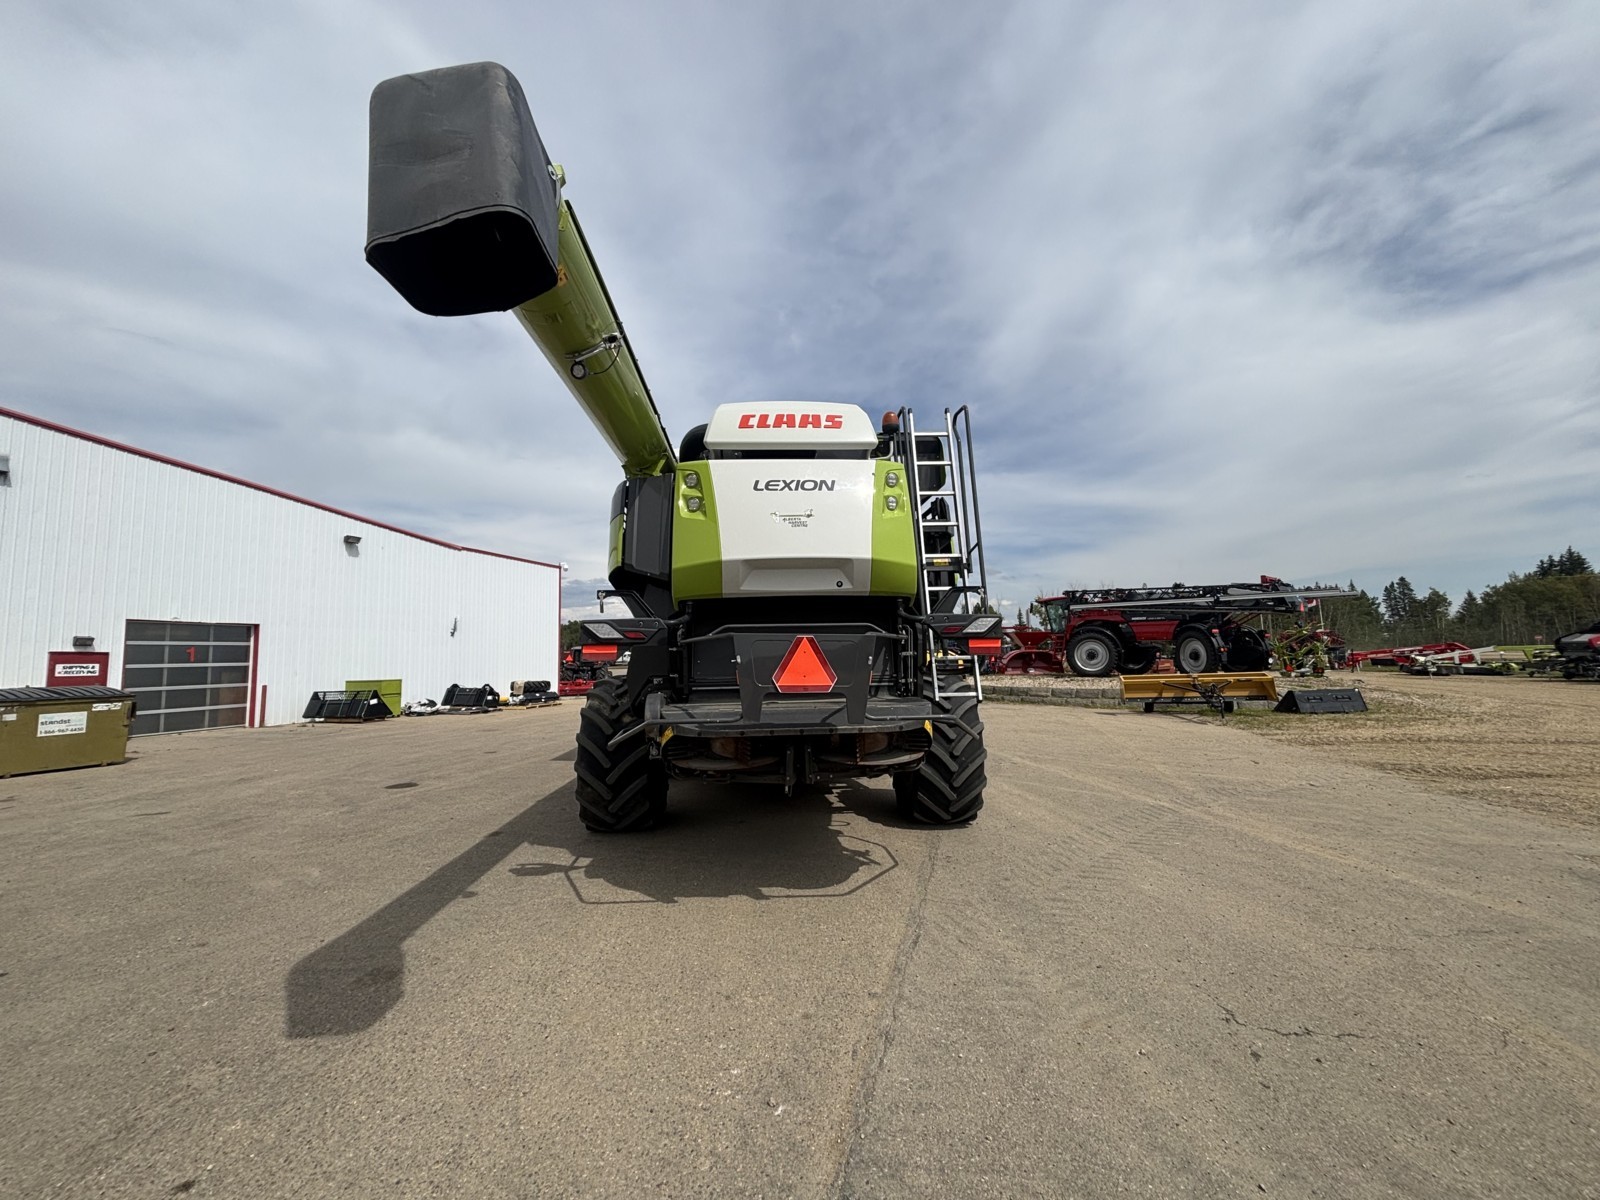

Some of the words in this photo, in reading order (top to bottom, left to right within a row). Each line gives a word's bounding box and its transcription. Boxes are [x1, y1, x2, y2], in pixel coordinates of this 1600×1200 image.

[738, 414, 843, 429] CLAAS
[753, 480, 836, 491] LEXION
[186, 646, 195, 662] 1
